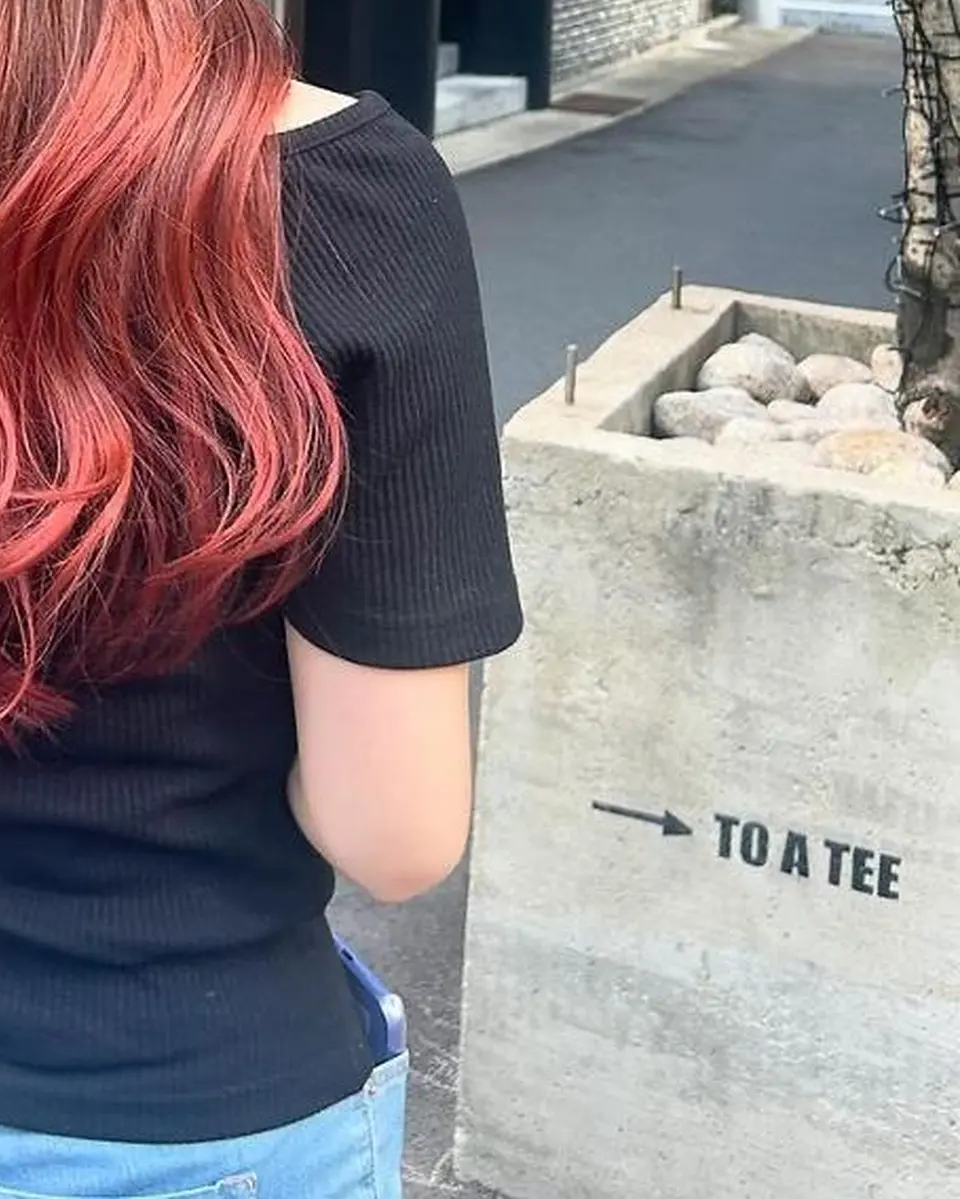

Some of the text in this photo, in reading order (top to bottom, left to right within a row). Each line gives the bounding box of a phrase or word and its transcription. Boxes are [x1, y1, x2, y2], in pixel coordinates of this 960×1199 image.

[714, 813, 902, 900] TO A TEE
